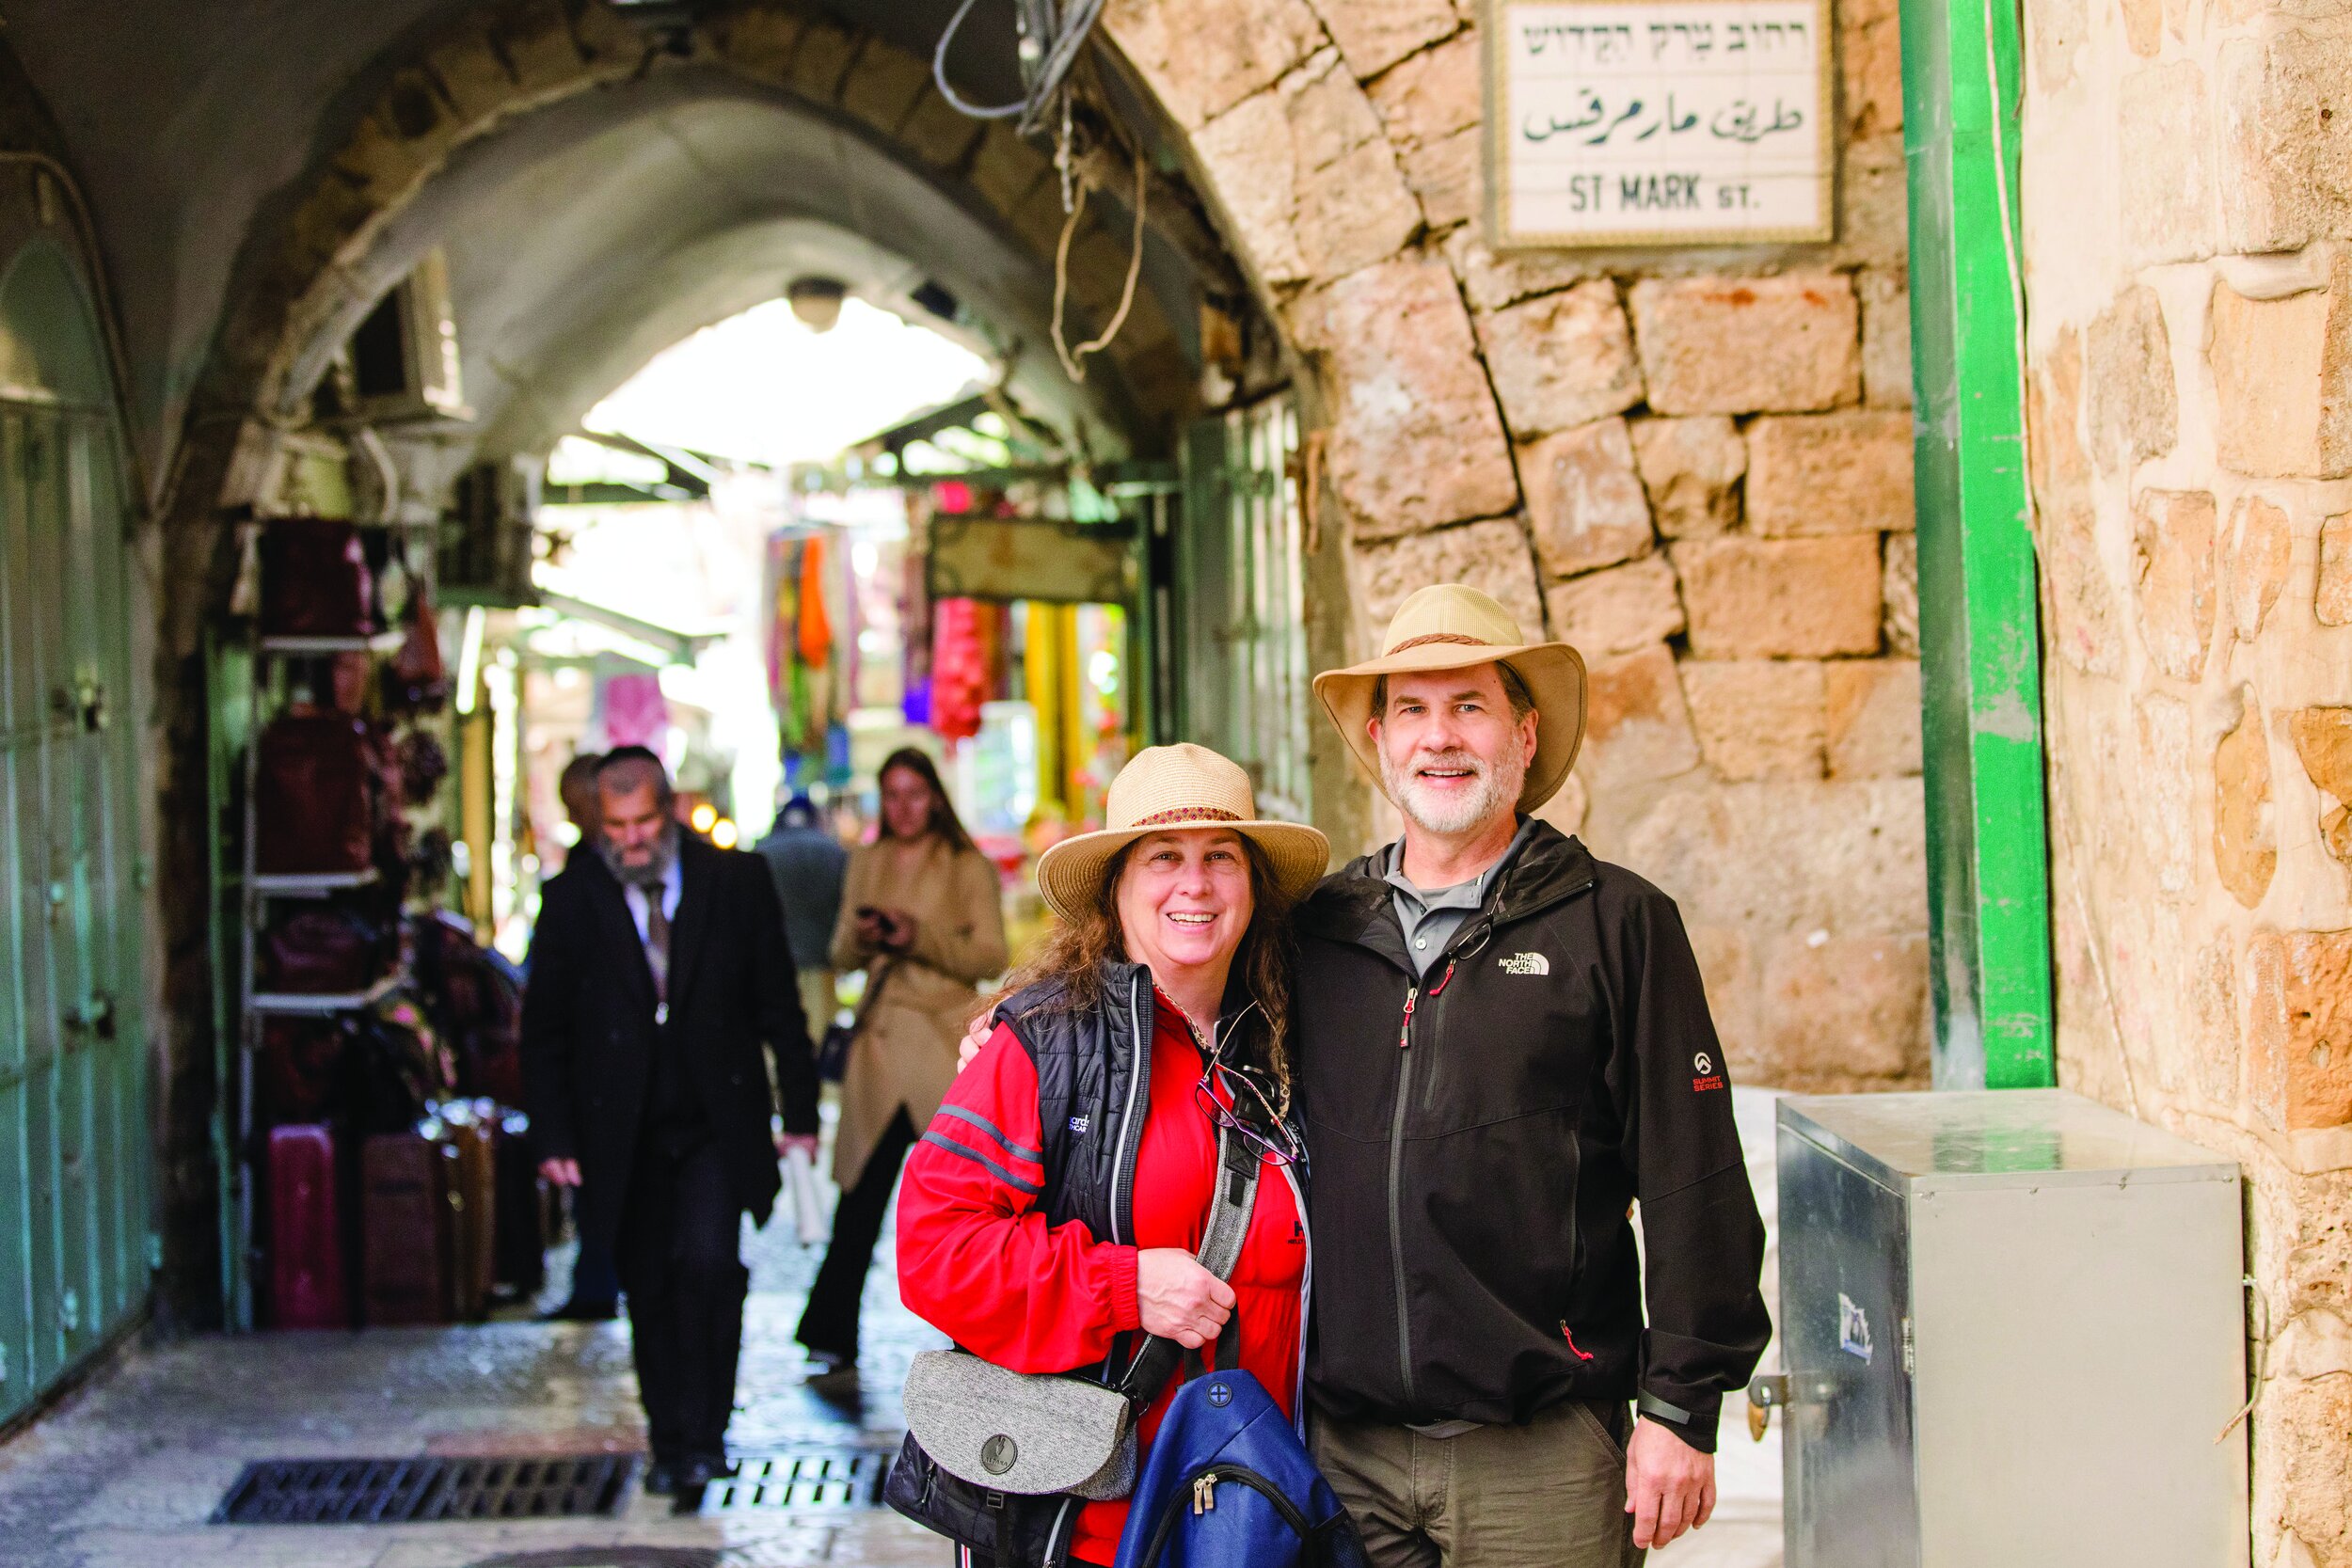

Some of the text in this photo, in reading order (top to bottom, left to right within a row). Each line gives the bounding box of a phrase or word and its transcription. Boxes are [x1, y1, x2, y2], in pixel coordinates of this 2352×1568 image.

[1710, 98, 1804, 143] طريق
[1570, 174, 1602, 213] ST
[1619, 173, 1701, 212] MARK
[1515, 952, 1533, 960] THE
[1499, 958, 1532, 967] NORTH
[1506, 966, 1531, 974] FACE
[1693, 1075, 1721, 1085] SUMMIT
[1694, 1082, 1724, 1091] SERIES
